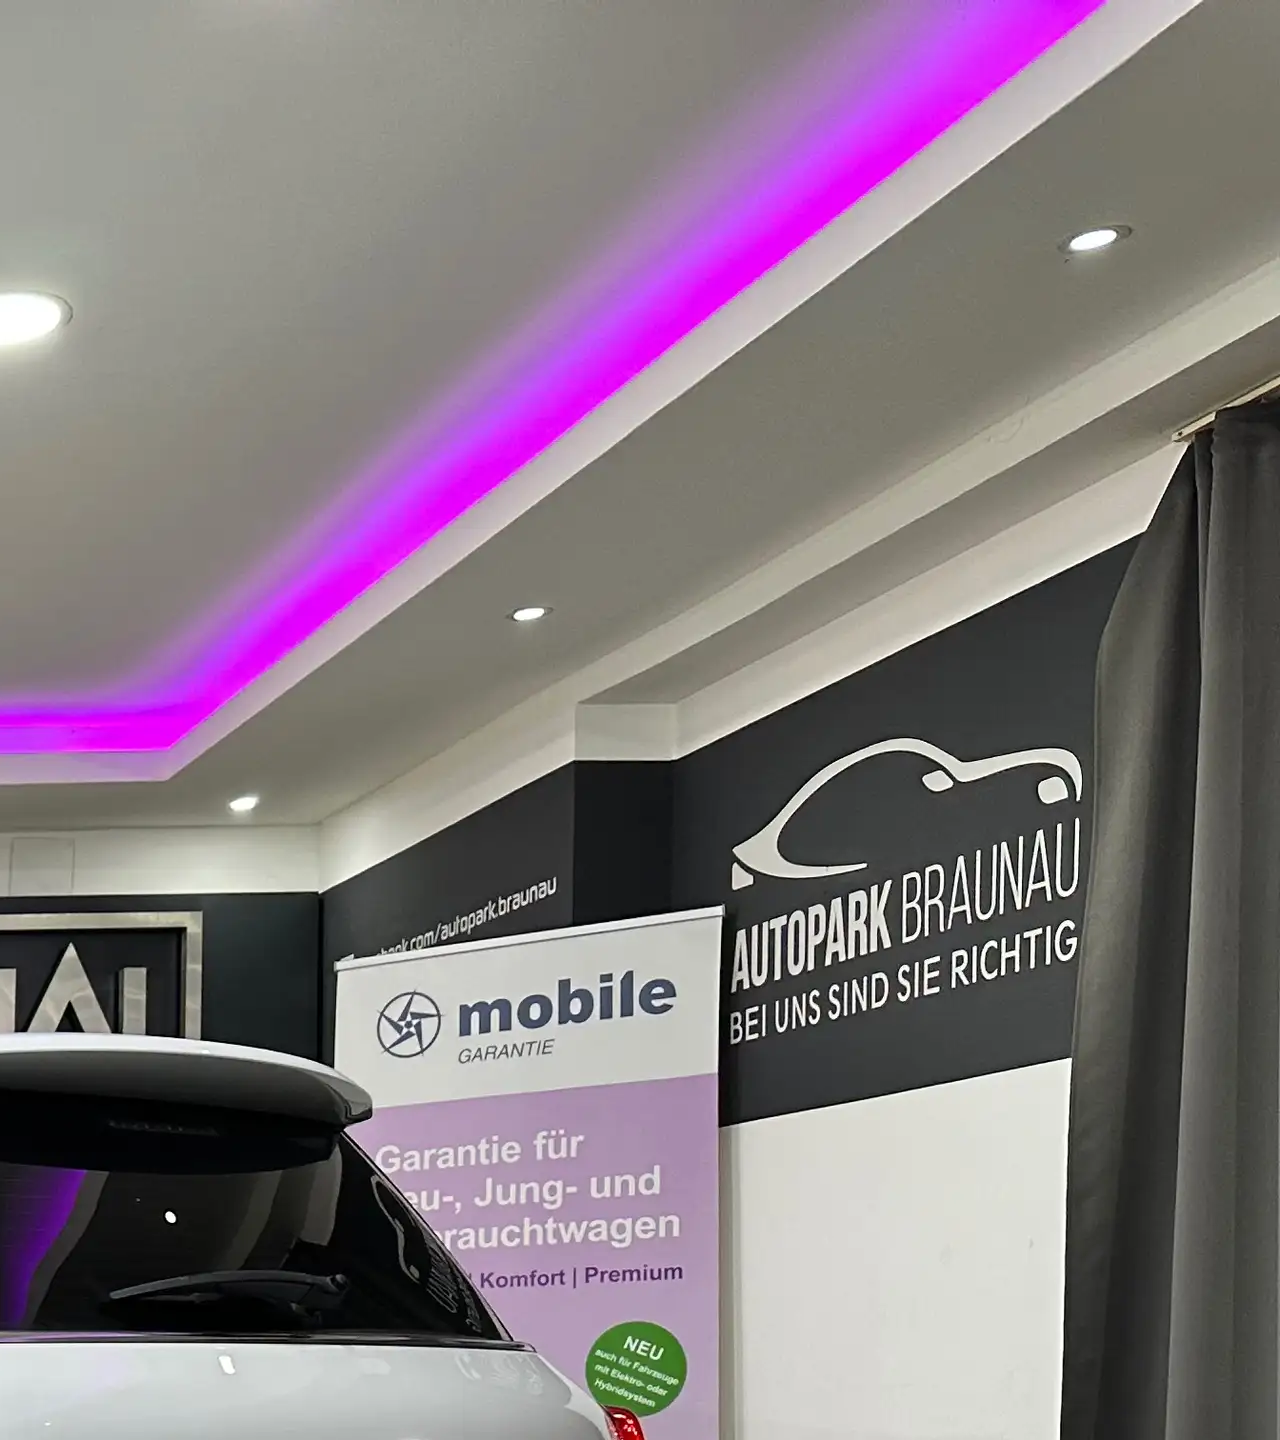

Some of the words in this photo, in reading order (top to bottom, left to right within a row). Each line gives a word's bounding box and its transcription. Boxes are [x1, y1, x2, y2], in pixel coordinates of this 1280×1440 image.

[730, 879, 893, 994] AUTOPARK
[901, 817, 1081, 945] BRAUNAU
[729, 1007, 768, 1046] BEI
[775, 988, 821, 1035] UNS
[827, 970, 890, 1022] SIND
[896, 954, 940, 1003] SIE
[951, 918, 1079, 989] RICHTIG
[458, 969, 677, 1037] mobile
[458, 1038, 555, 1064] GARANTIE
[375, 1135, 522, 1174] Garantie
[533, 1129, 585, 1161] für
[403, 1188, 462, 1214] eu-,
[474, 1177, 578, 1209] Jung-
[590, 1165, 661, 1198] und
[435, 1214, 680, 1249] rauchtwagen
[480, 1270, 566, 1289] Komfort
[584, 1264, 683, 1285] Premium
[595, 1349, 617, 1362] auch
[623, 1335, 664, 1361] NEU
